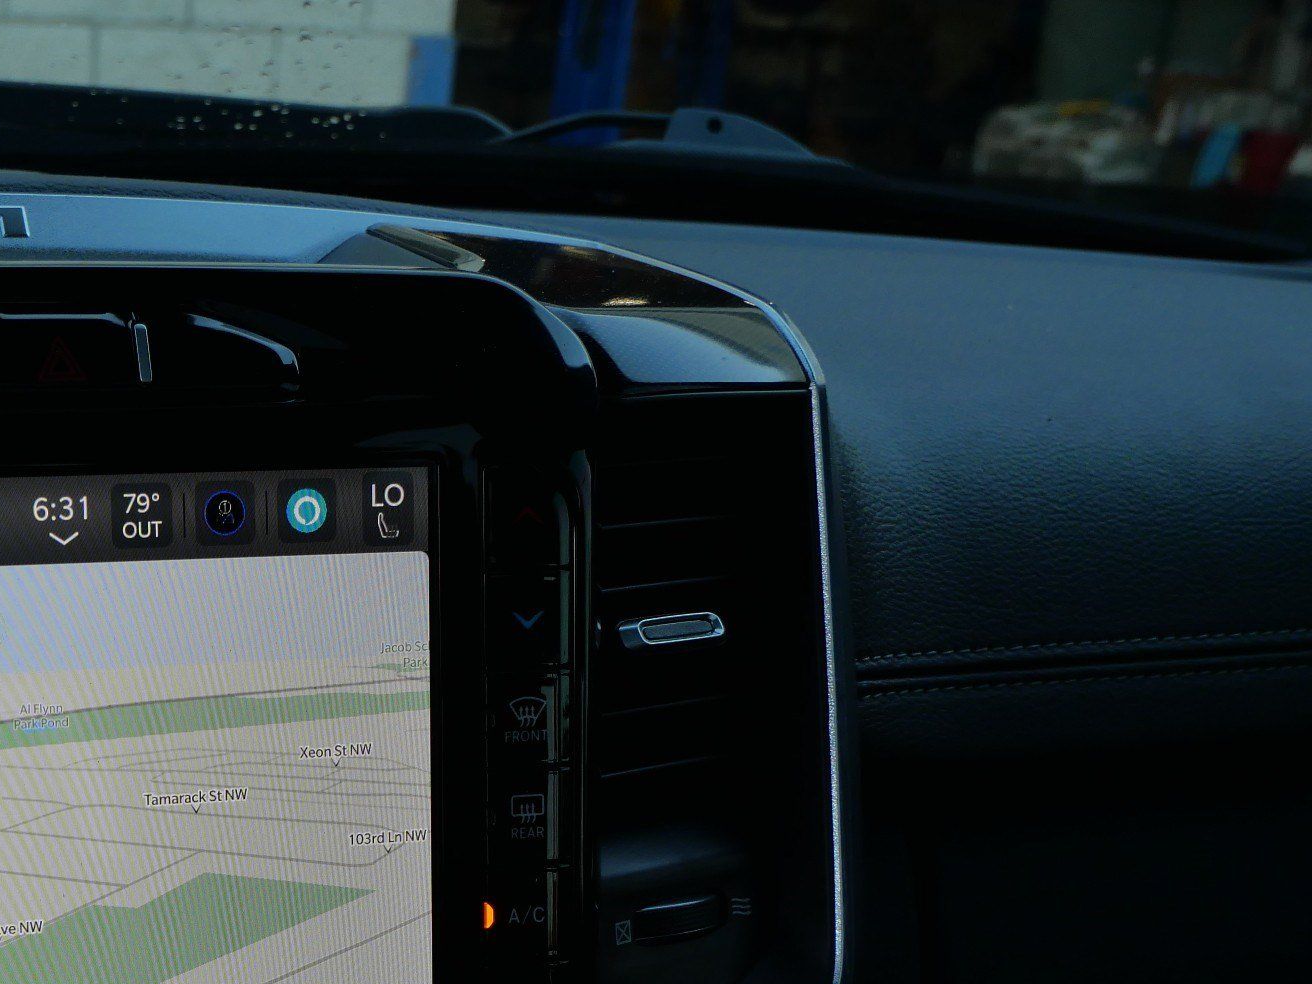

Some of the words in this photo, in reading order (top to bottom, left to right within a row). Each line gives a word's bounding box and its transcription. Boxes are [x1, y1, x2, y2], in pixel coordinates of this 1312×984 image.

[371, 483, 405, 507] LO
[33, 496, 88, 522] 6:31
[123, 493, 160, 514] 79°
[122, 520, 163, 539] OUT
[380, 640, 412, 655] Jacob
[34, 703, 63, 717] Flynn
[14, 718, 38, 730] Park
[41, 717, 69, 729] Pond
[504, 728, 548, 743] FRONT
[300, 746, 331, 758] Xeon
[334, 744, 348, 757] St
[350, 743, 372, 756] NW
[145, 791, 207, 806] Tamarack
[209, 789, 222, 802] St
[225, 788, 248, 801] NW
[349, 833, 385, 846] 103rd
[388, 832, 402, 844] Ln
[405, 830, 427, 842] NW
[511, 826, 545, 839] REAR
[508, 904, 545, 925] A/C
[19, 921, 43, 934] NW
